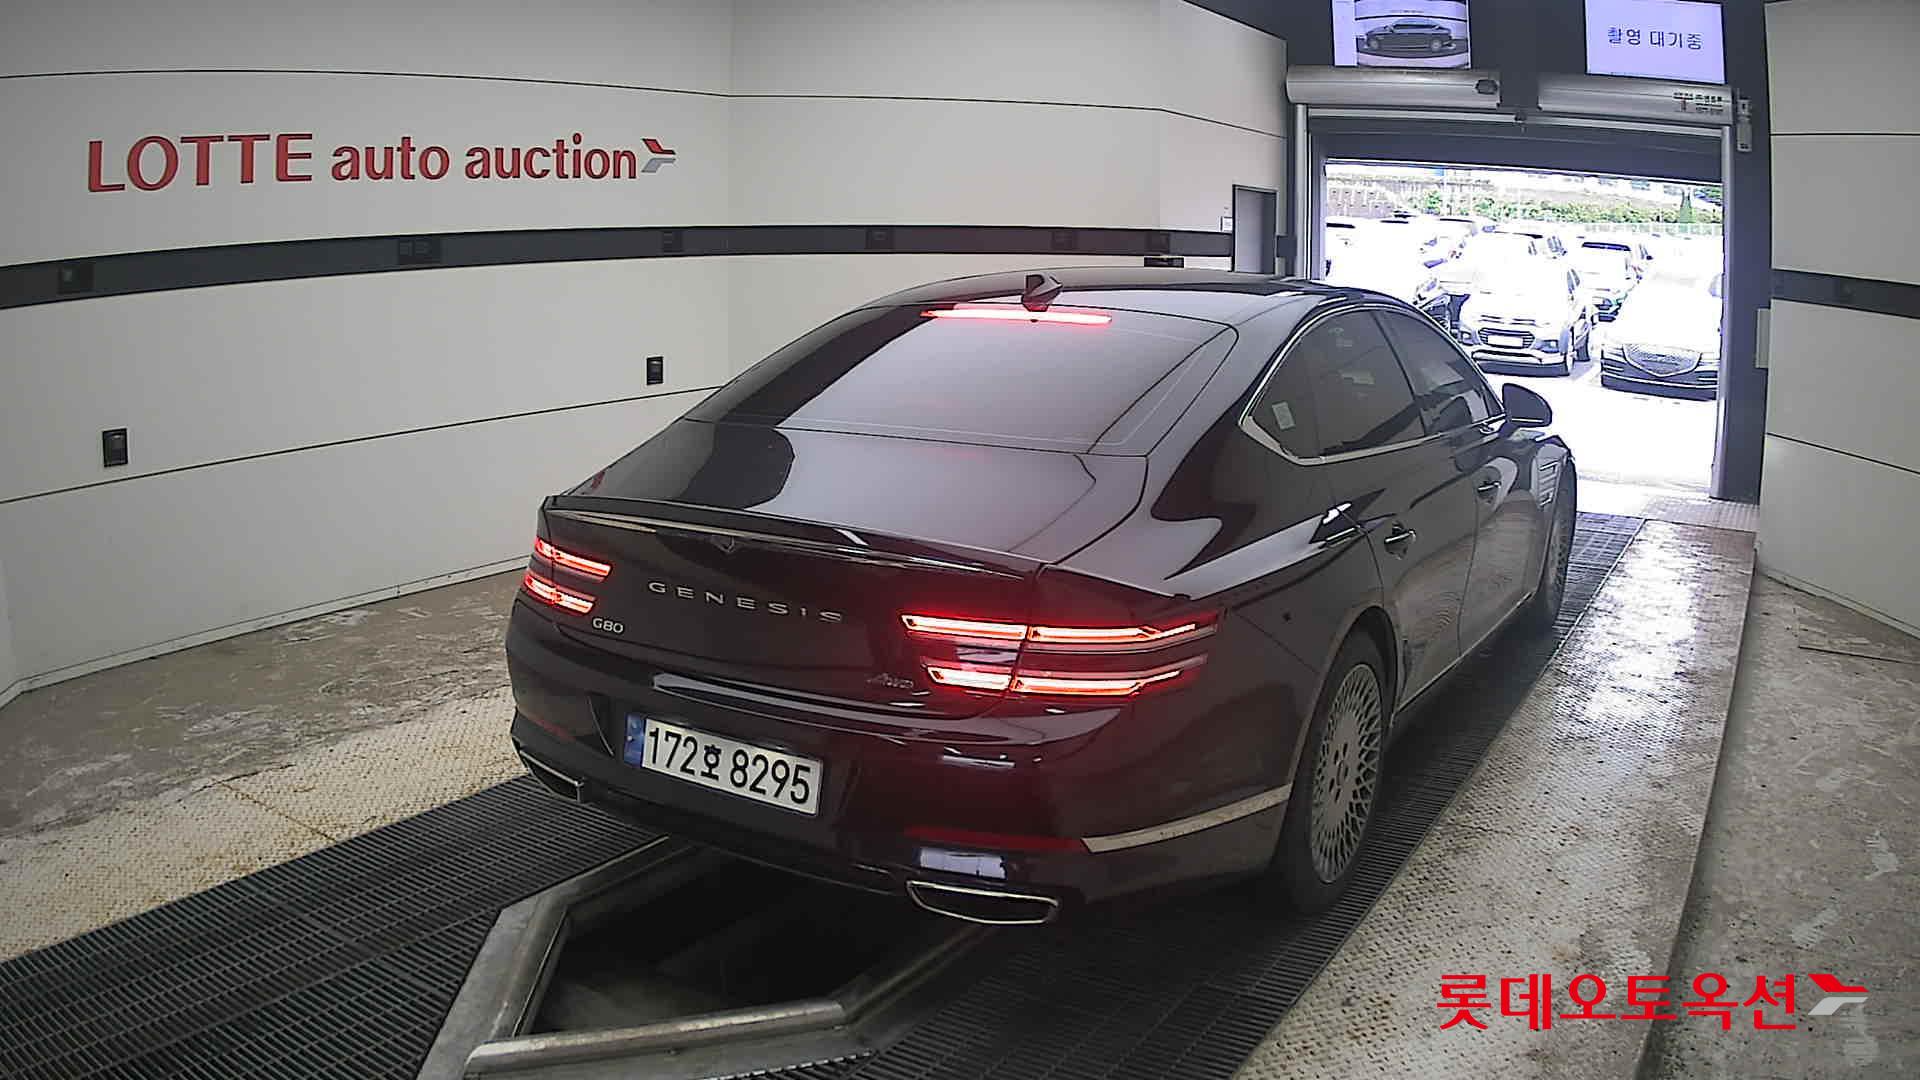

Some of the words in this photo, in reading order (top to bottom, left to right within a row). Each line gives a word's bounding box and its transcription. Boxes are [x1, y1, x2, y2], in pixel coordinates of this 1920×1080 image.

[1650, 31, 1702, 50] 대기중
[88, 133, 313, 192] LOTTE
[331, 136, 450, 180] auto
[465, 132, 637, 179] auction
[648, 582, 842, 623] GENESIS
[592, 618, 624, 634] G80
[650, 727, 721, 781] 172호
[730, 748, 811, 804] 8295
